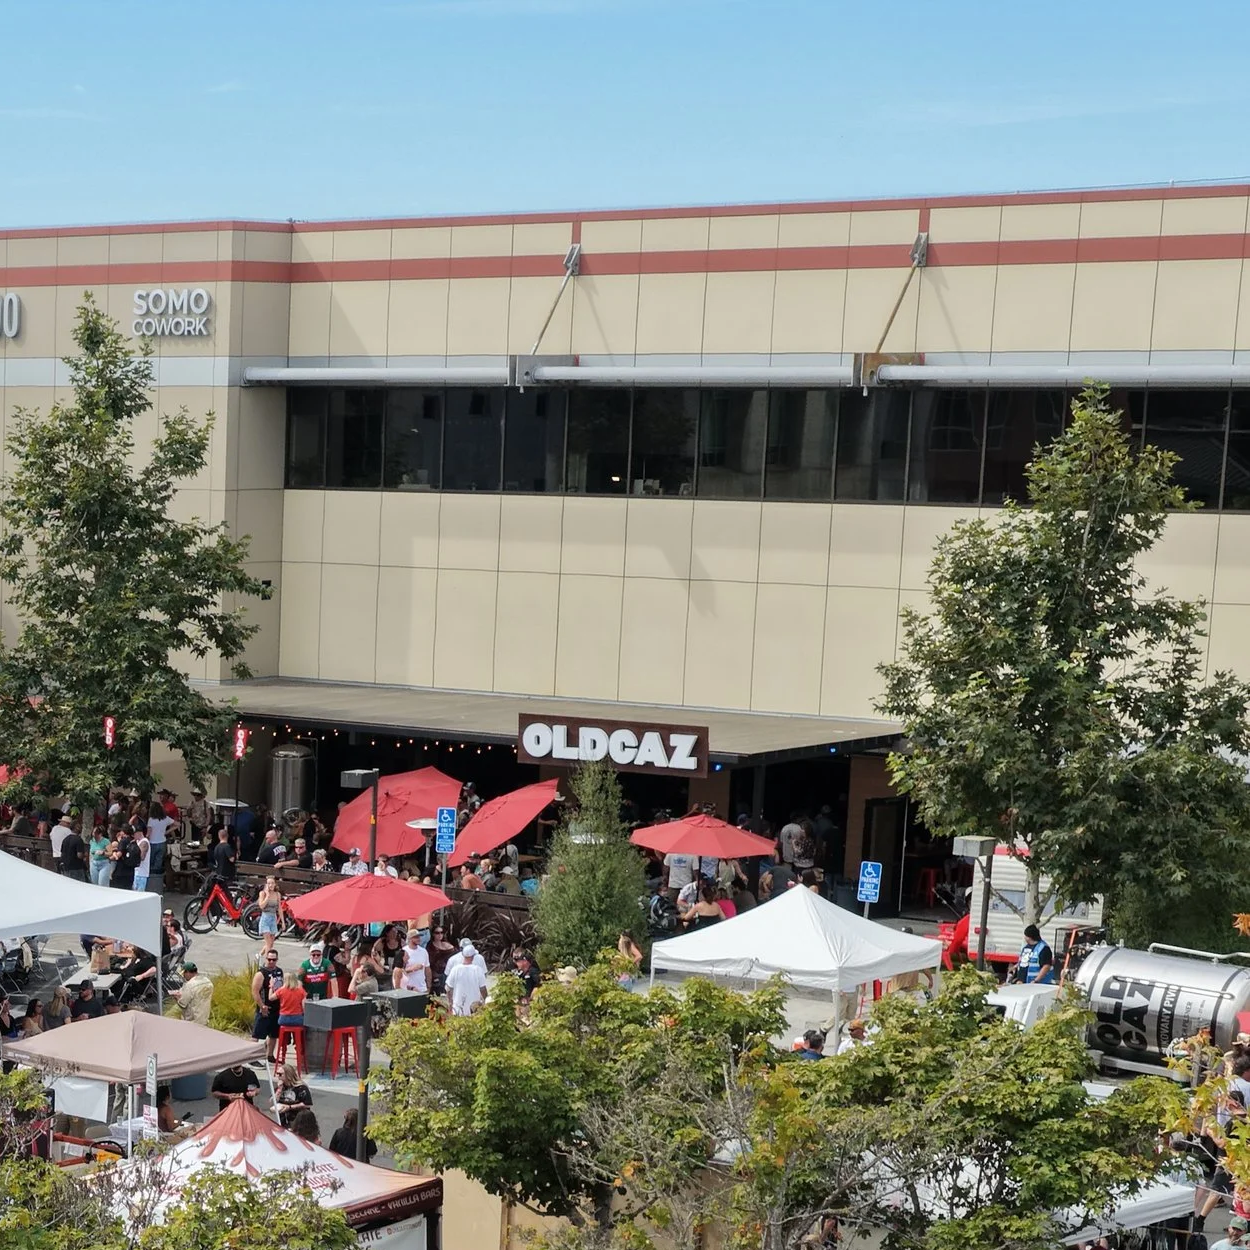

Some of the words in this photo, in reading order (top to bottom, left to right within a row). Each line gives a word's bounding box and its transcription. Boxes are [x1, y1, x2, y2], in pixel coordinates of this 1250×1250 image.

[133, 289, 209, 316] SOMO
[132, 317, 208, 336] COWORK
[105, 718, 114, 745] OLD
[236, 729, 246, 757] CAZ
[1097, 975, 1127, 1047] OLD
[1122, 982, 1154, 1051] CAZ
[387, 1194, 420, 1211] VANILLA
[420, 1187, 441, 1201] BARS
